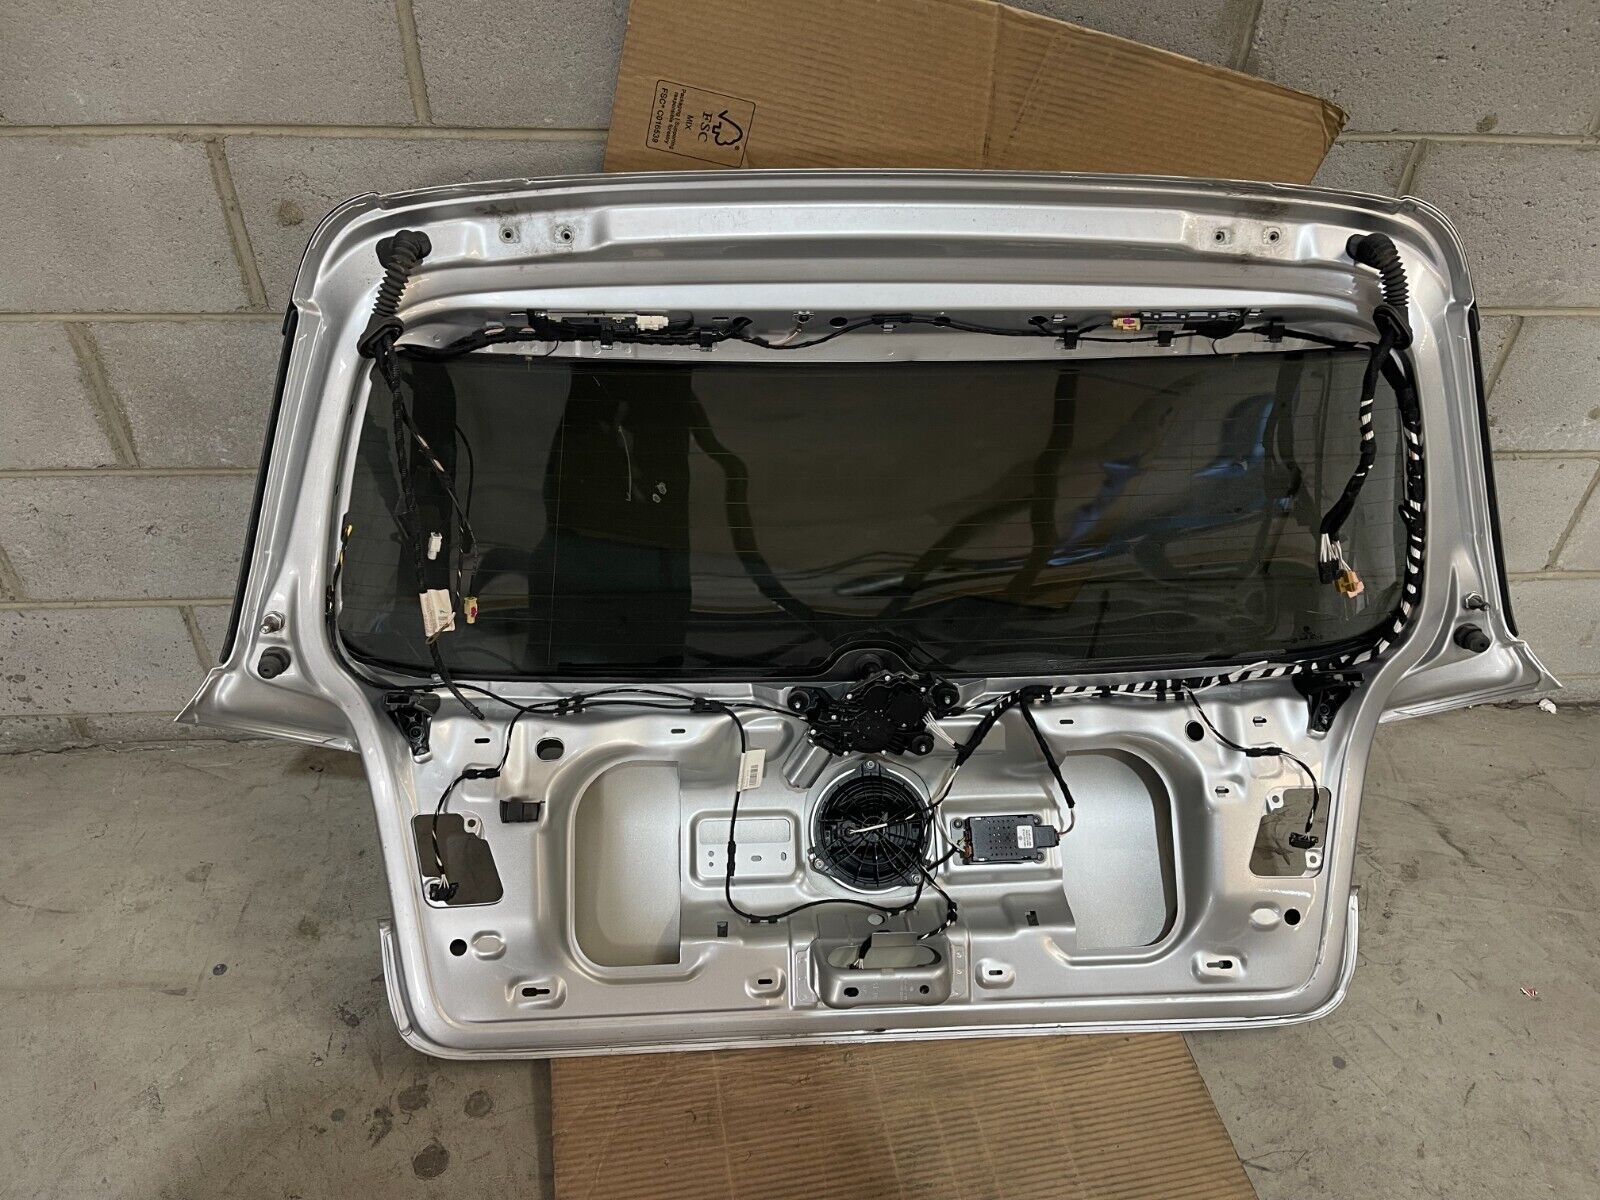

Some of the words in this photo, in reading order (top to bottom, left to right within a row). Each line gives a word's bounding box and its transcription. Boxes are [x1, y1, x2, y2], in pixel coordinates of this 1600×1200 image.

[669, 91, 679, 122] responsible
[676, 88, 687, 117] Packaging
[664, 123, 674, 144] forestry
[668, 121, 680, 150] Supporting
[685, 114, 694, 131] MIX
[698, 111, 713, 142] FSC
